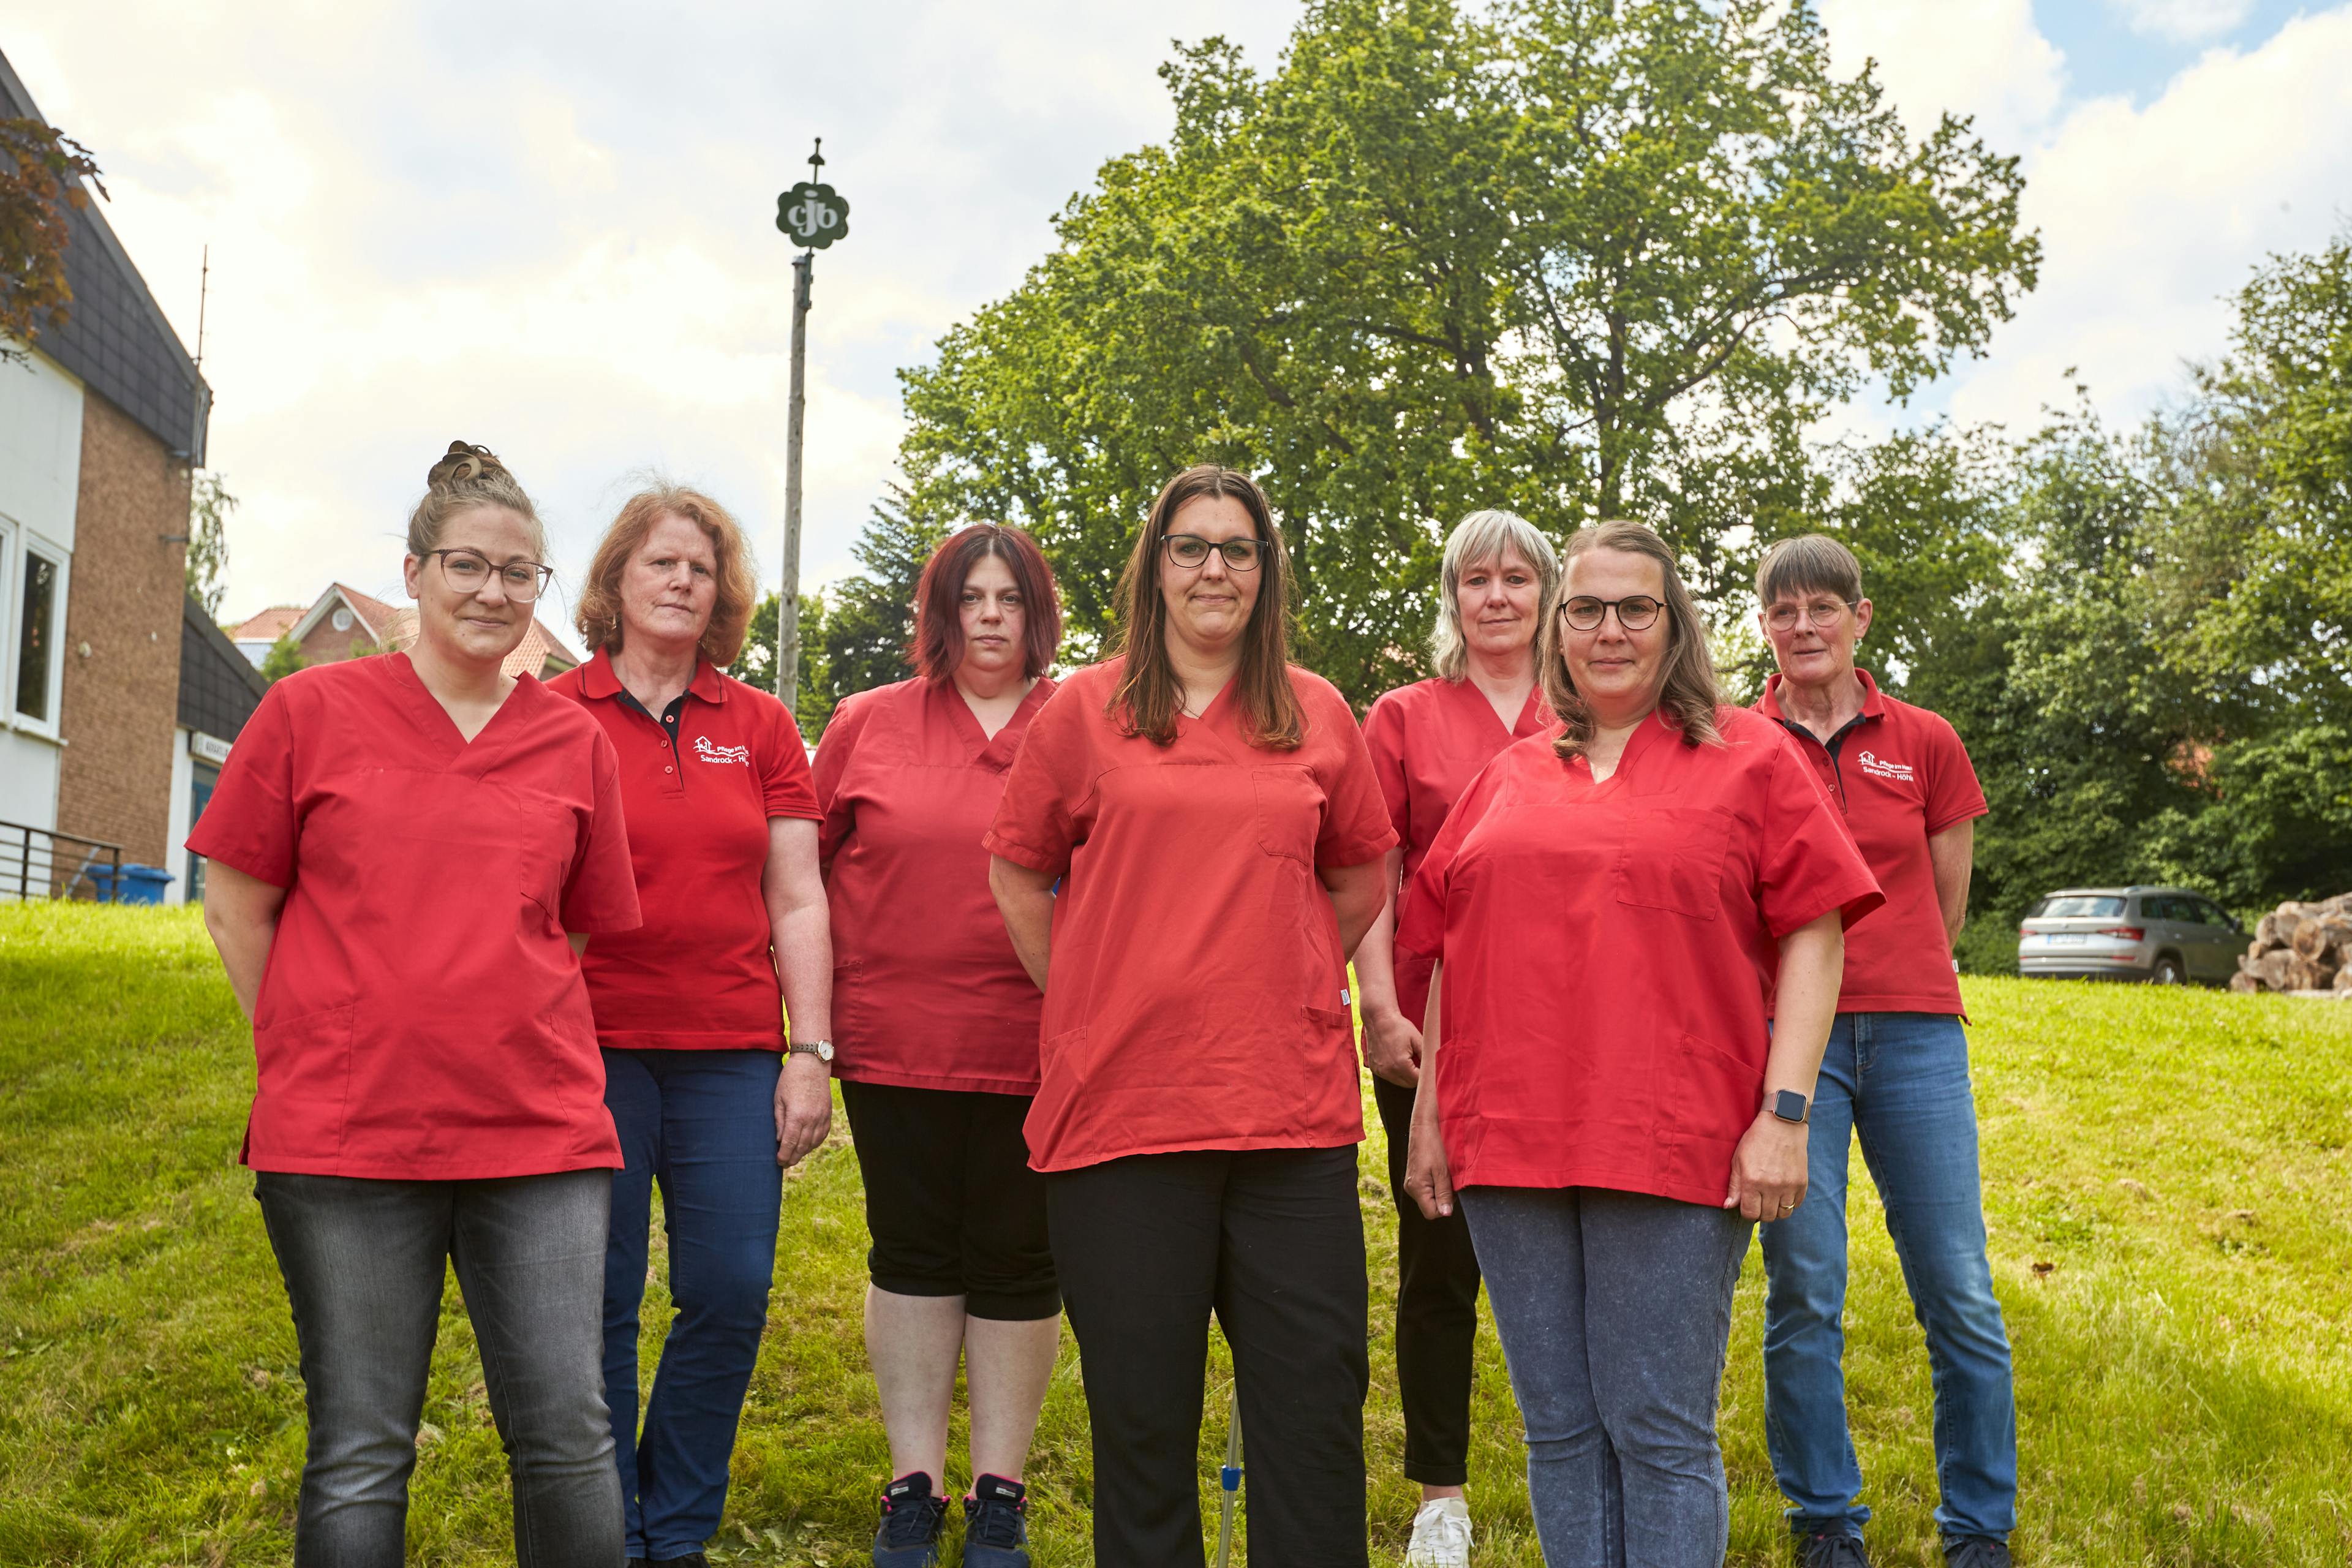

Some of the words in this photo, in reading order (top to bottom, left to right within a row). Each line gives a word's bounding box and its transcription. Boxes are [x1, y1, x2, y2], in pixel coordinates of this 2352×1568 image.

[700, 755, 733, 764] Sandrock
[1879, 760, 1894, 769] Pflege
[1863, 766, 1891, 778] Sandrock
